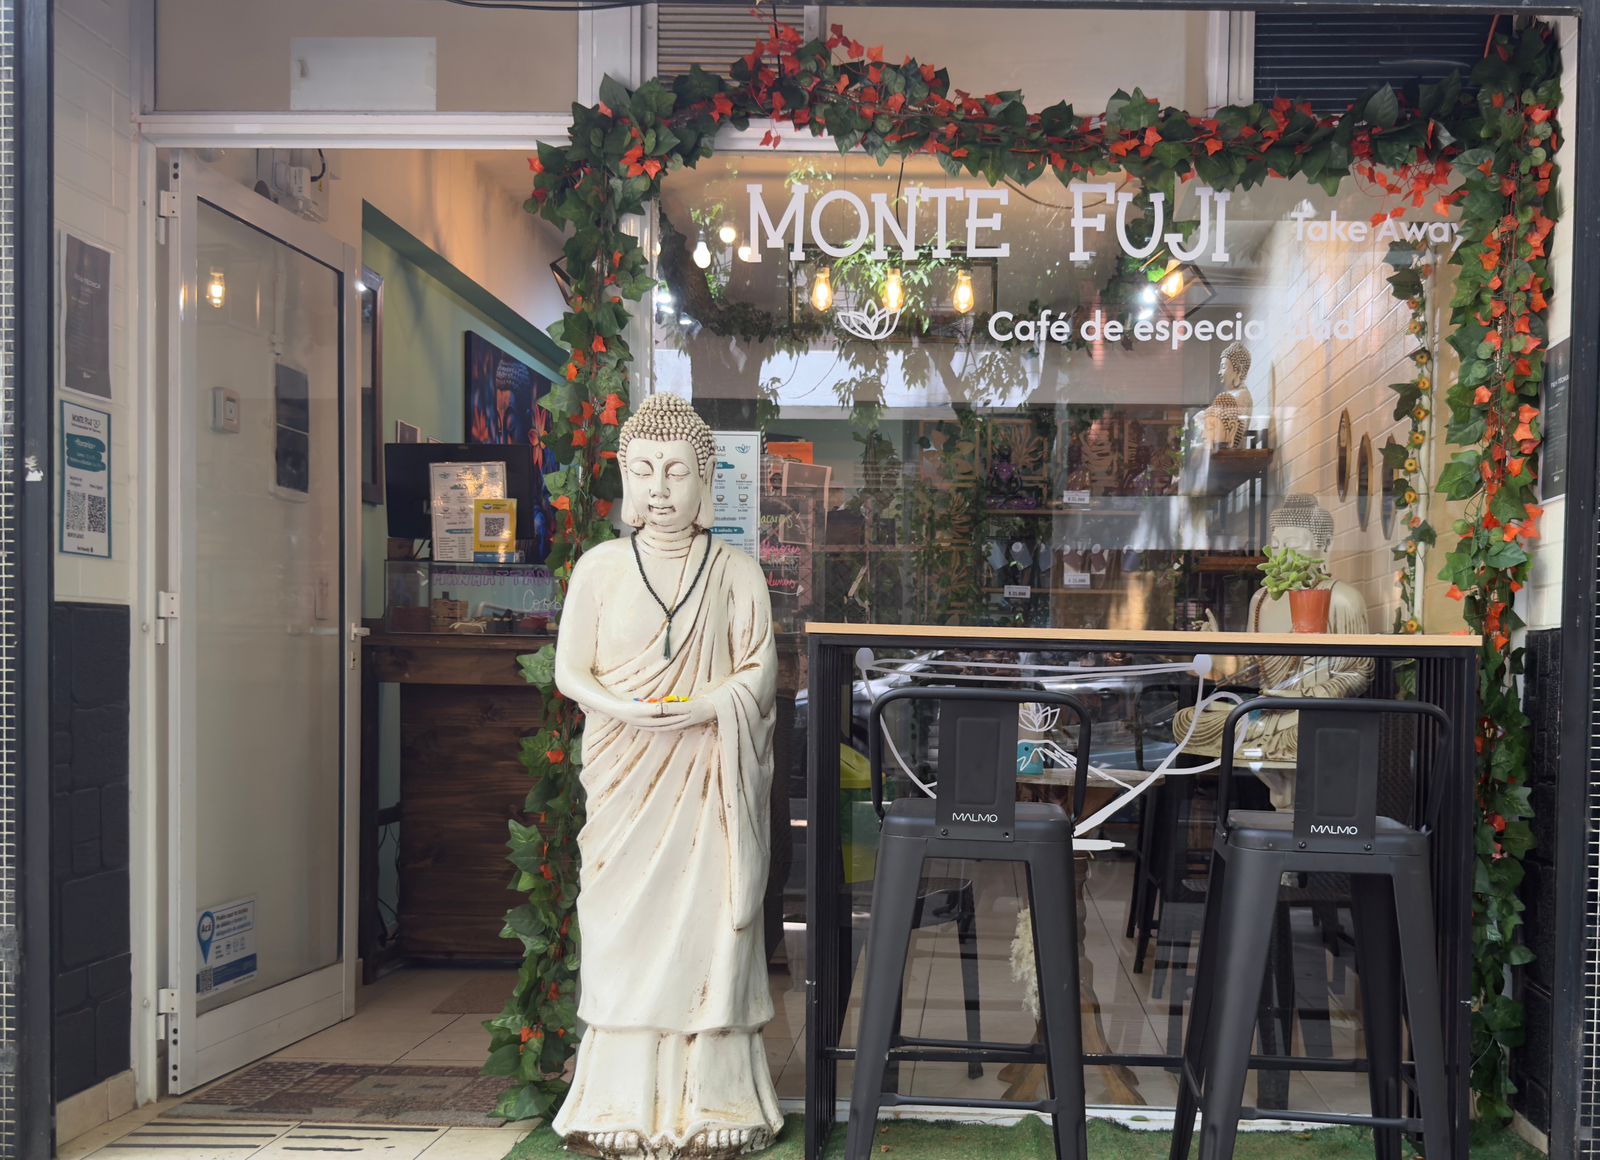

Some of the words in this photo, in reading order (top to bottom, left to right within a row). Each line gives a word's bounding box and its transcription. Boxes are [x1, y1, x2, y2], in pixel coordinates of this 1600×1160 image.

[746, 183, 1011, 263] MONTE
[1069, 182, 1231, 262] FUJI
[1290, 209, 1368, 243] Take
[987, 309, 1070, 342] Café
[1080, 309, 1124, 341] de
[952, 812, 998, 823] MALMO
[1310, 824, 1358, 835] MALMO
